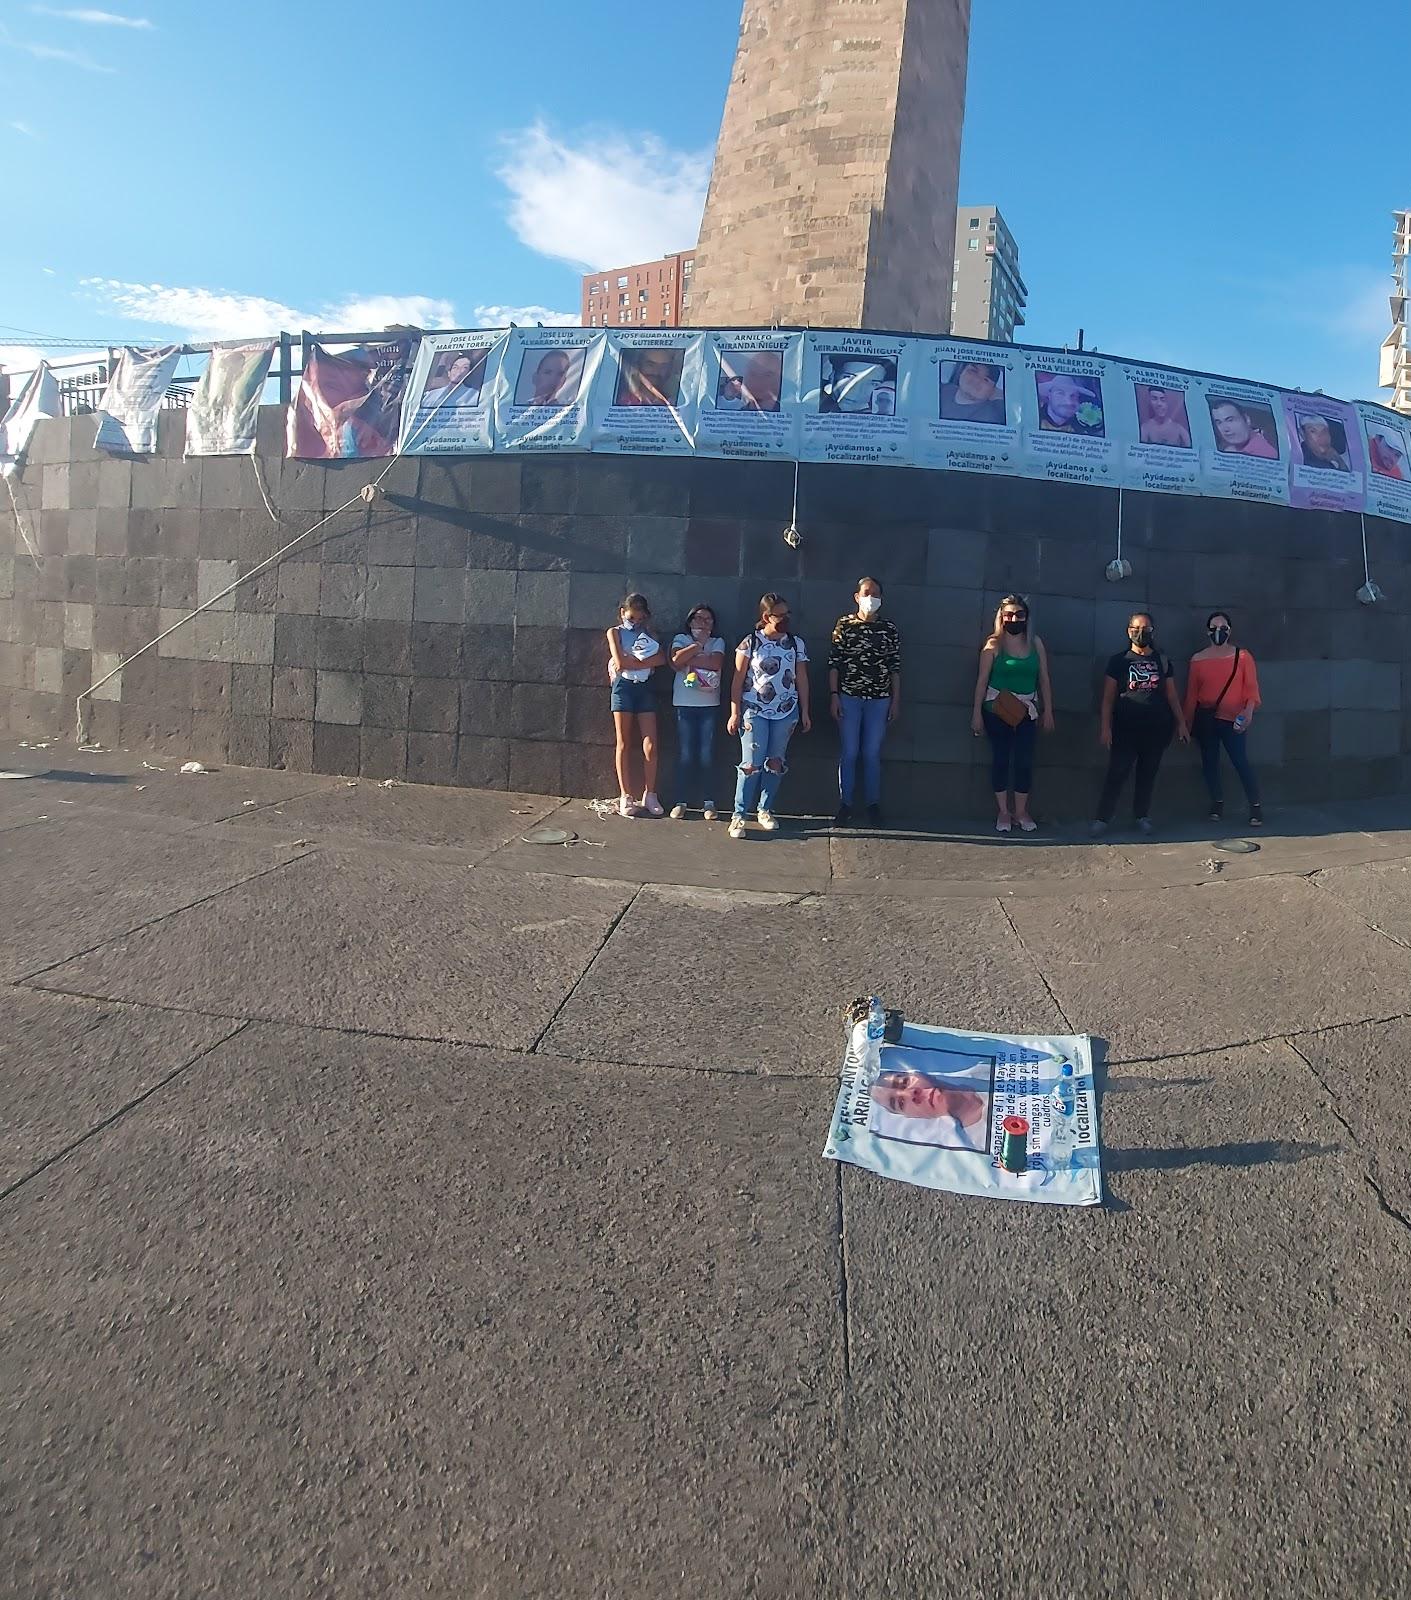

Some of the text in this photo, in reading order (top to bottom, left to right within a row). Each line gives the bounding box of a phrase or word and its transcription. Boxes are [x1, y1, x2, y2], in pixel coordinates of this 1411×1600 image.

[842, 337, 872, 346] JAVIER
[1037, 355, 1093, 368] LUIS ALBERTO
[1025, 362, 1105, 376] PARRA VILLALOBOS
[1047, 470, 1092, 482] localizarlo!
[997, 1052, 1006, 1062] del
[1020, 1048, 1030, 1074] playera
[995, 1063, 1008, 1081] Mayo
[1007, 1084, 1015, 1093] 32
[1030, 1076, 1039, 1095] short
[1007, 1095, 1015, 1104] de
[1042, 1094, 1051, 1127] cuadros.
[1074, 1077, 1090, 1144] localizarlo!
[1031, 1104, 1041, 1135] mangas
[1030, 1137, 1041, 1150] sin
[1030, 1152, 1043, 1170] roja
